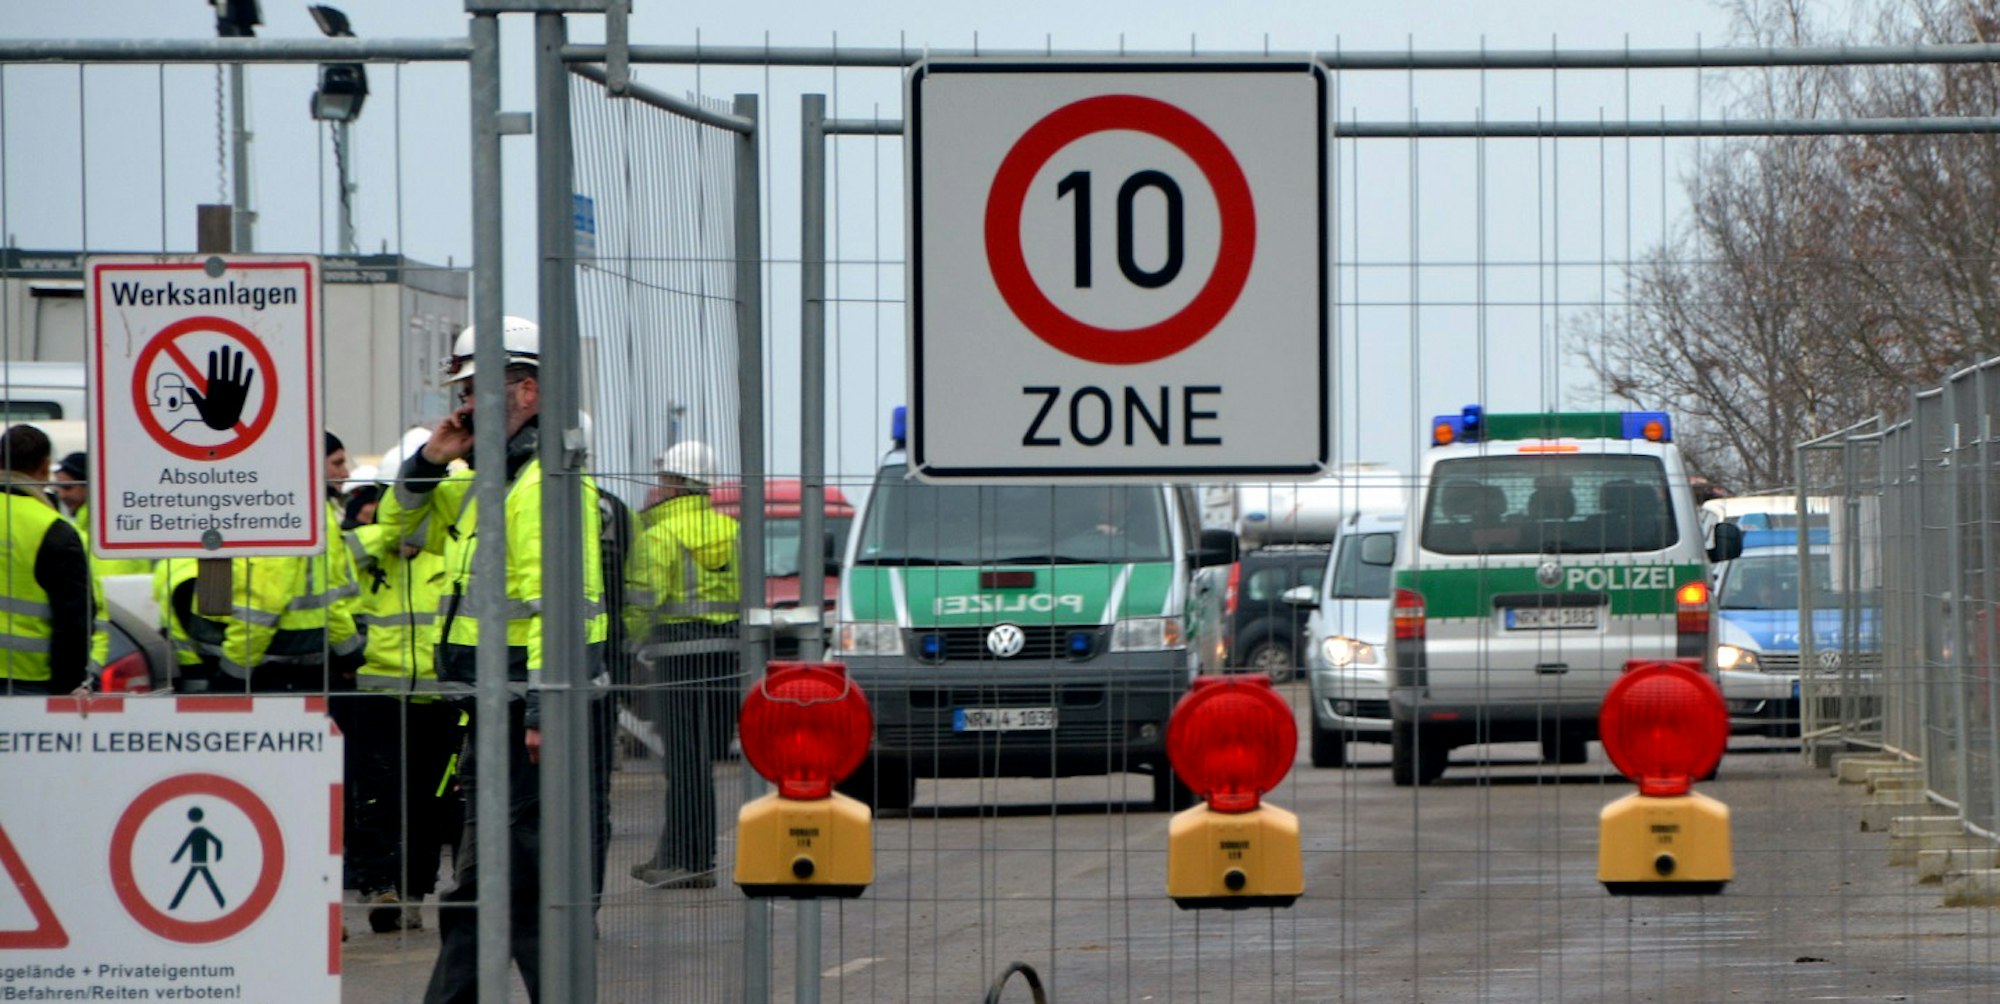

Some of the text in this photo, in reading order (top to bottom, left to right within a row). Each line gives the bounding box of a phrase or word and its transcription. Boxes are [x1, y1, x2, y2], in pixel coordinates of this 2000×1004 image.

[1056, 170, 1185, 289] 10
[111, 281, 297, 310] Werksanlagen
[1022, 386, 1223, 447] ZONE
[159, 468, 258, 484] Absolutes
[123, 490, 295, 510] Betretungsverbot
[116, 513, 302, 531] für Betriebsfremde
[1567, 567, 1675, 590] POLIZEI
[0, 732, 323, 752] EITEN! LEBENSGEFAHR!
[98, 964, 235, 981] Privateigentum
[155, 985, 241, 999] verboten!
